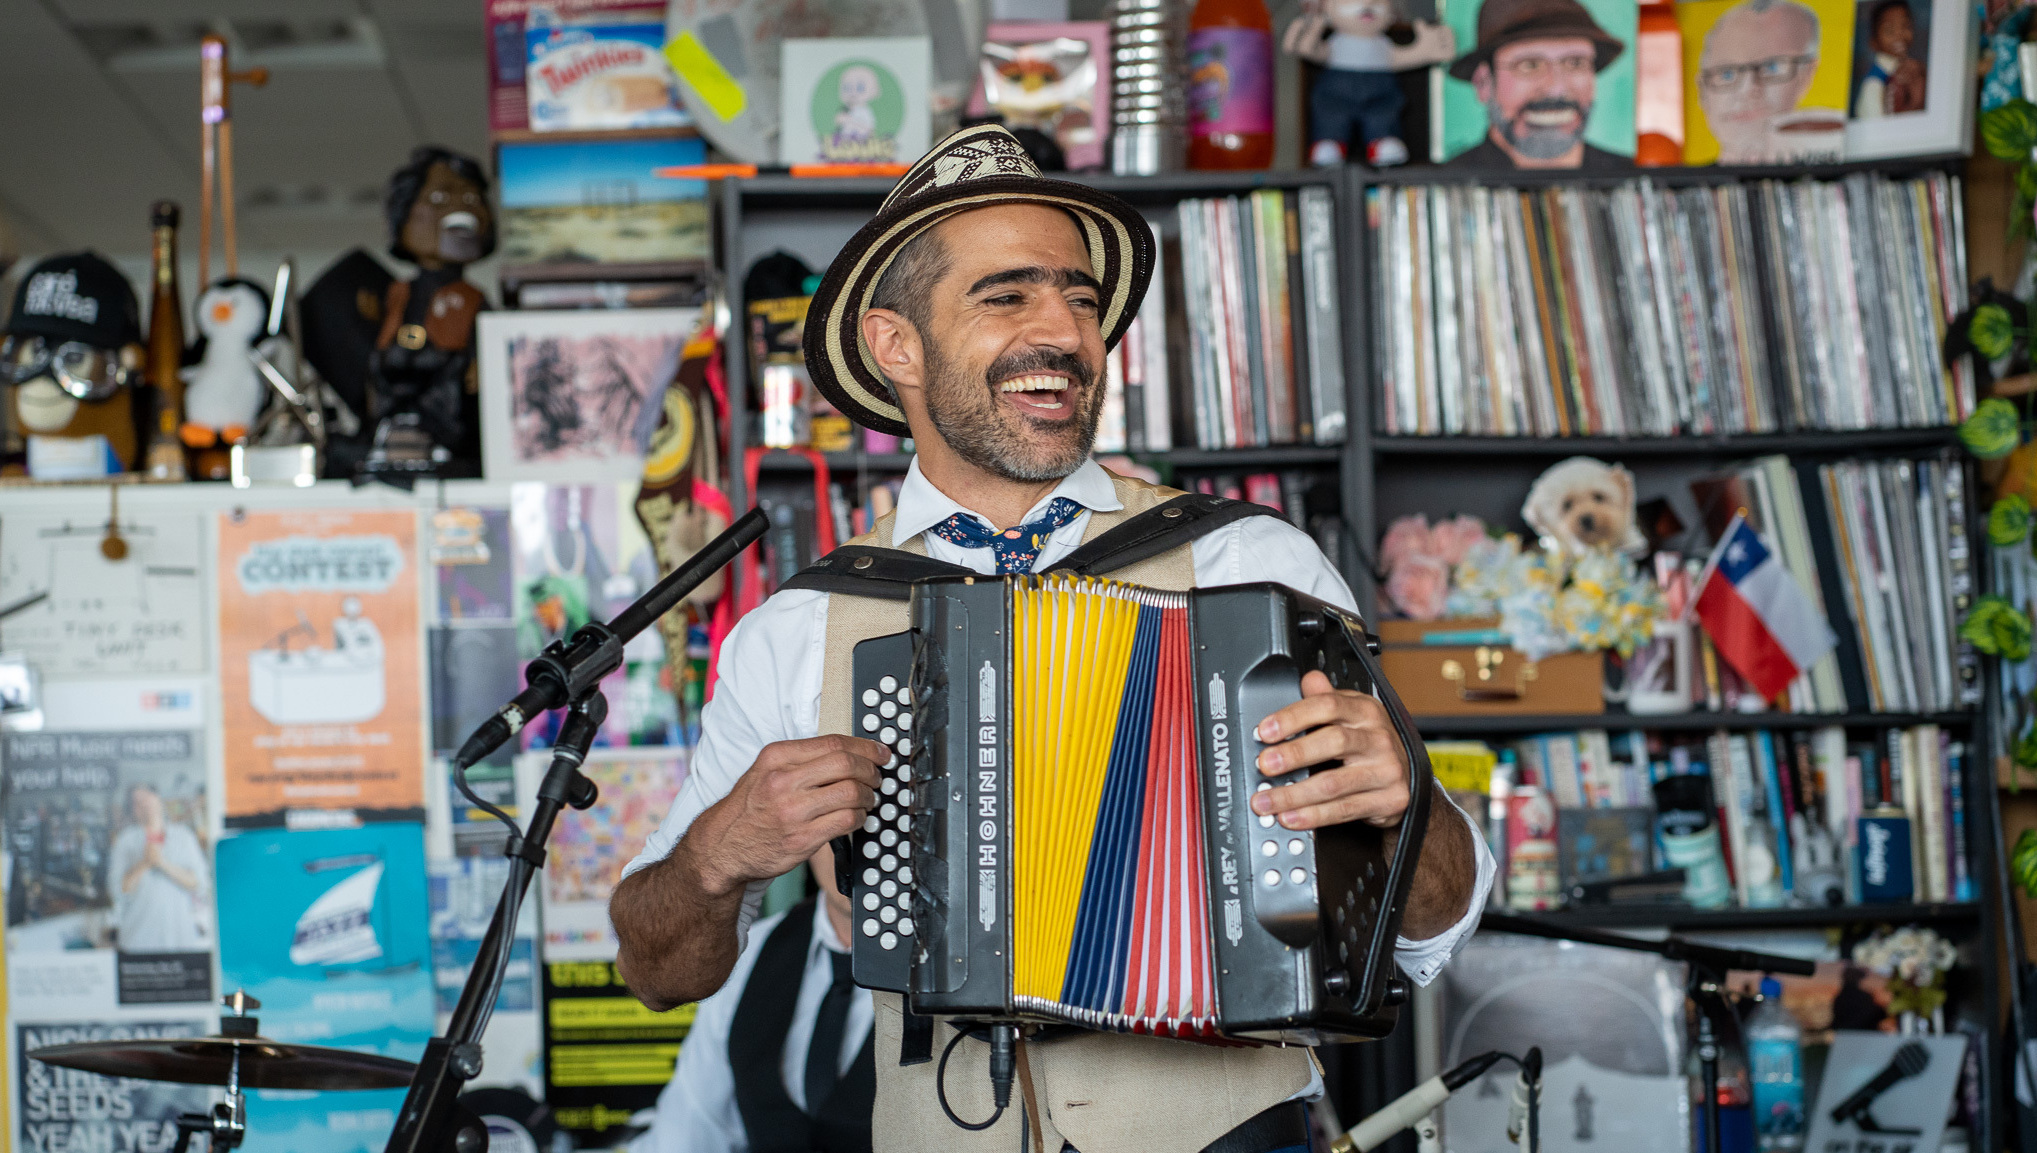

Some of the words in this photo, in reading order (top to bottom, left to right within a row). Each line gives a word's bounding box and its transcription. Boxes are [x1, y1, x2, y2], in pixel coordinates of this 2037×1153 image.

[538, 48, 645, 95] Twinkies
[242, 557, 394, 583] CONTEST
[979, 725, 997, 868] HOHNER
[1212, 722, 1233, 832] VALLENATO
[1220, 846, 1239, 885] REY
[27, 1087, 133, 1121] SEEDS
[27, 1121, 113, 1152] YEAH
